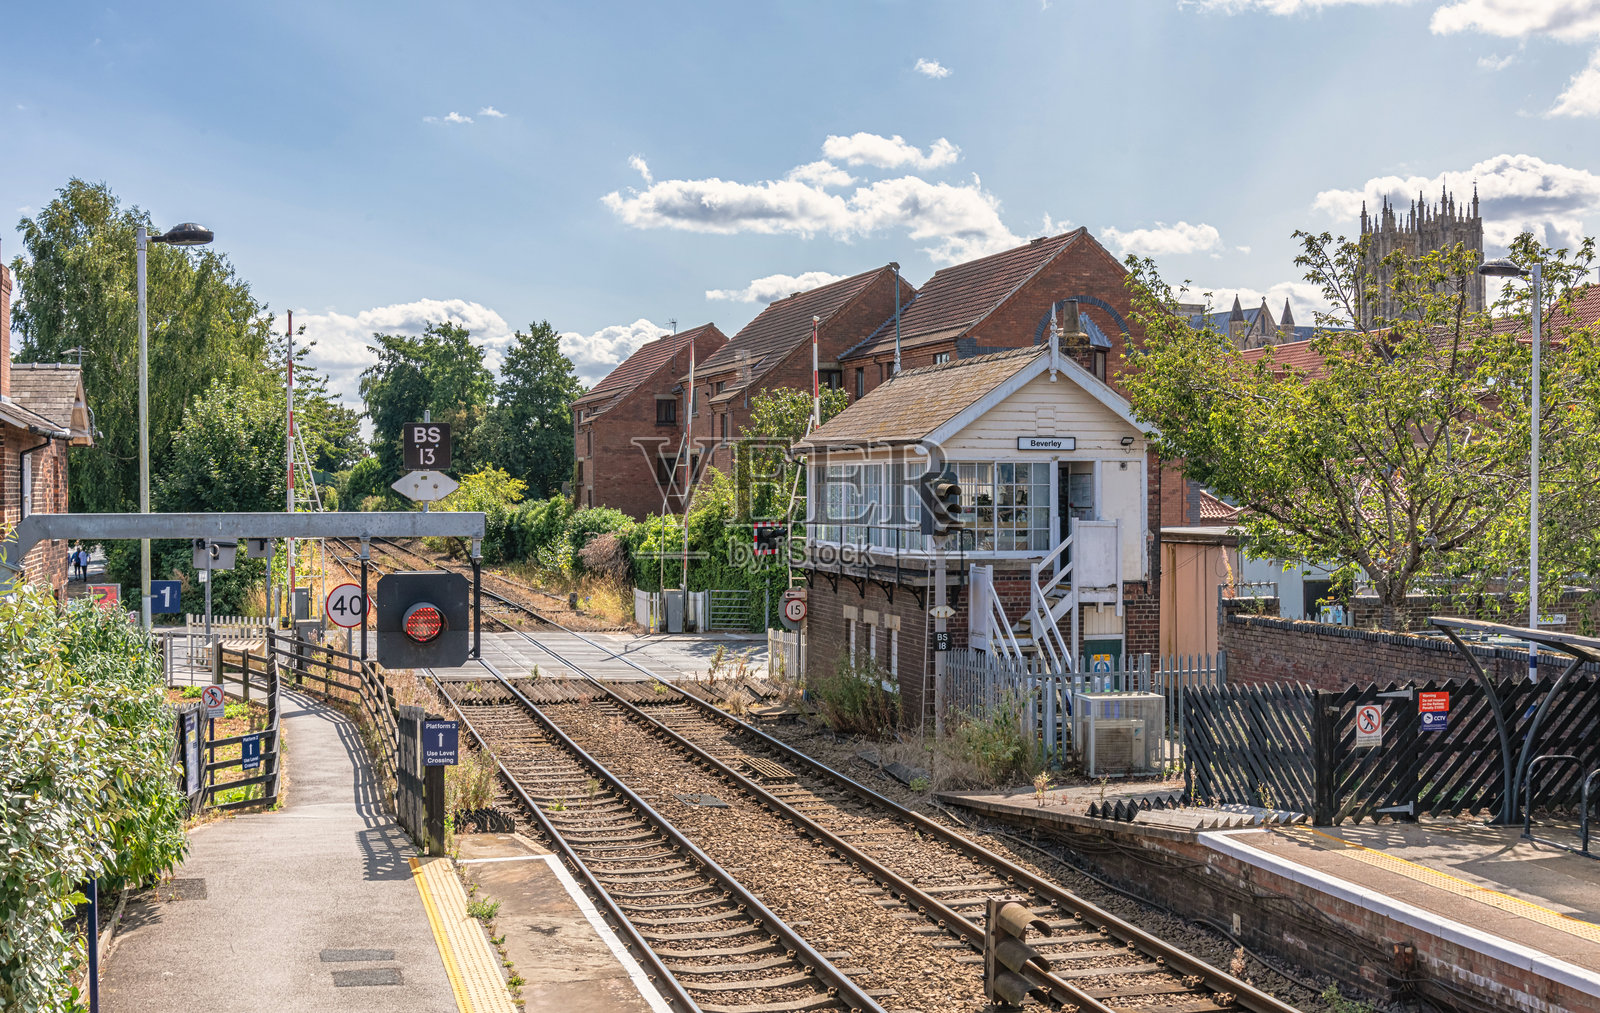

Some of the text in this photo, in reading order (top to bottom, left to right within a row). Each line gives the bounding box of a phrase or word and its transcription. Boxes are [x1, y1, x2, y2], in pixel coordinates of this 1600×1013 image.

[414, 427, 440, 443] BS
[1031, 440, 1062, 448] Beverley
[420, 448, 435, 465] 13
[160, 586, 170, 607] 1
[332, 595, 363, 616] 40
[791, 605, 801, 615] 15
[937, 633, 948, 641] BS
[938, 642, 946, 650] 18
